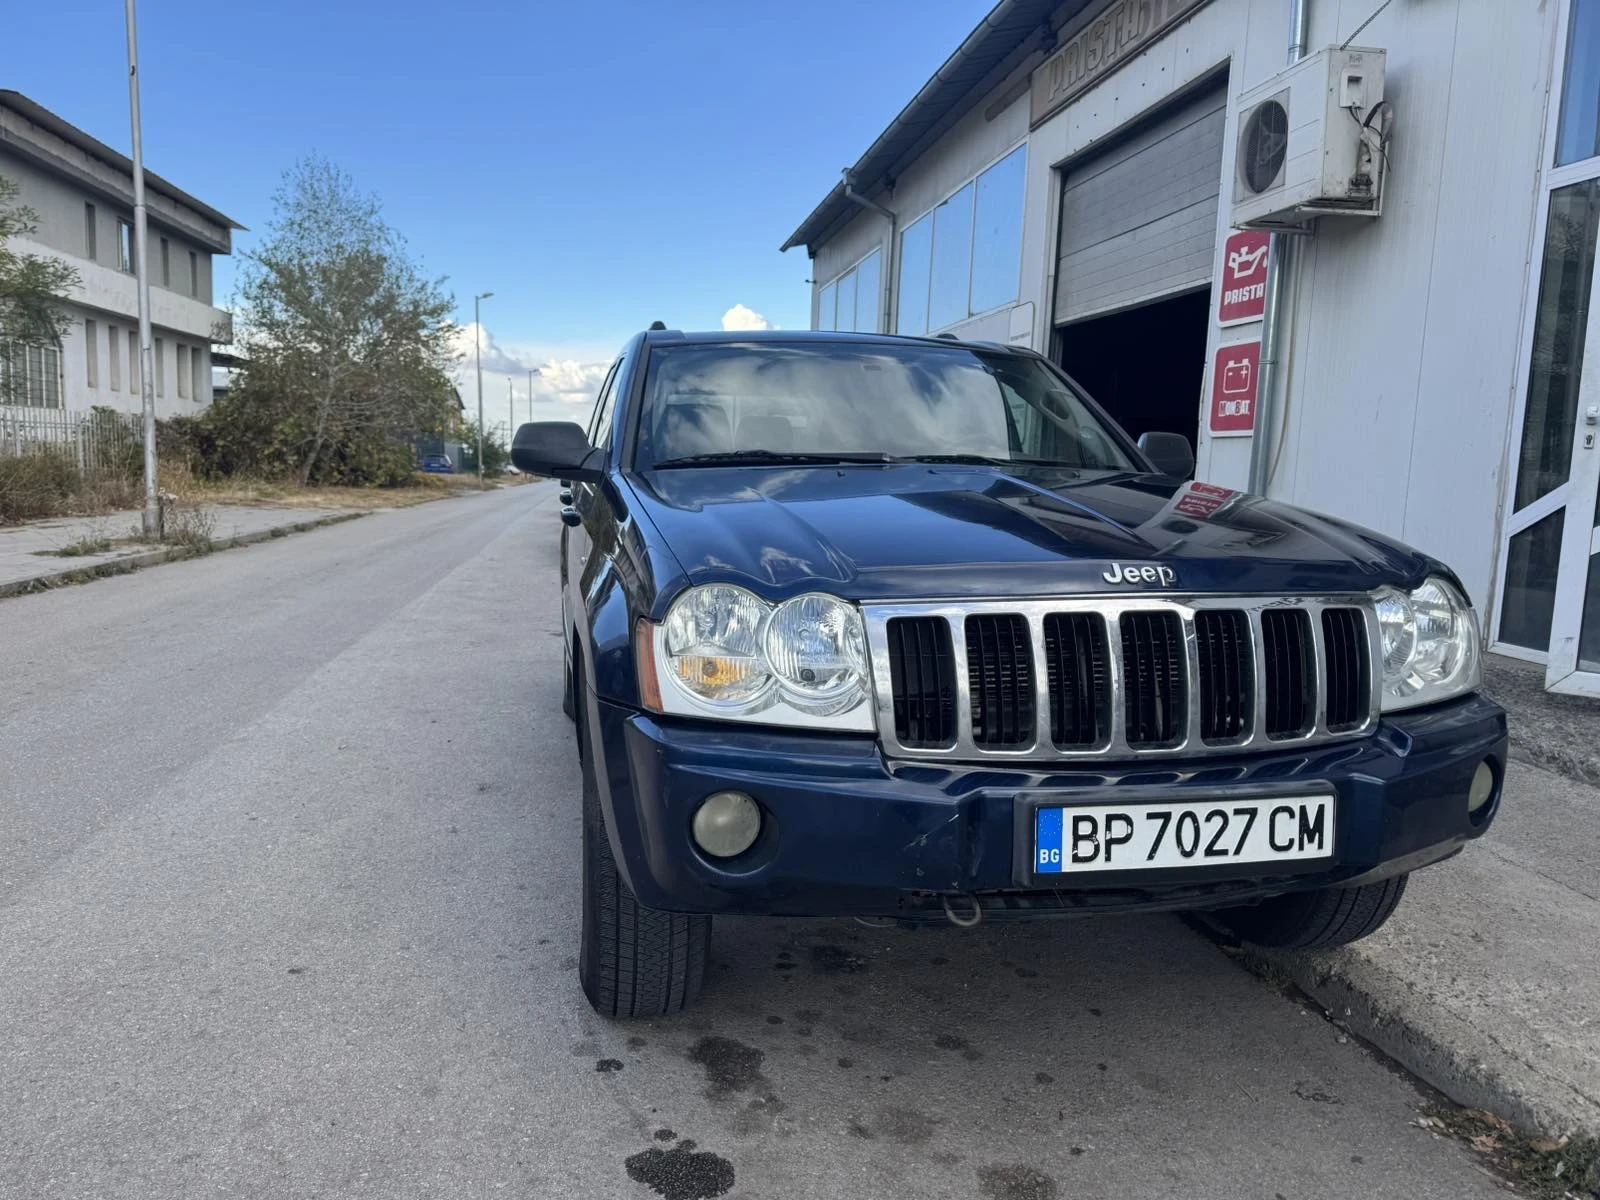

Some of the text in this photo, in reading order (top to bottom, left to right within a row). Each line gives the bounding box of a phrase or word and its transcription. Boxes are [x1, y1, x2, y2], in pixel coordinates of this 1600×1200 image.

[1224, 282, 1265, 306] PRISTA
[1103, 562, 1176, 587] Jeep
[1071, 803, 1325, 864] BP 7027 CM
[1039, 848, 1060, 864] BG
